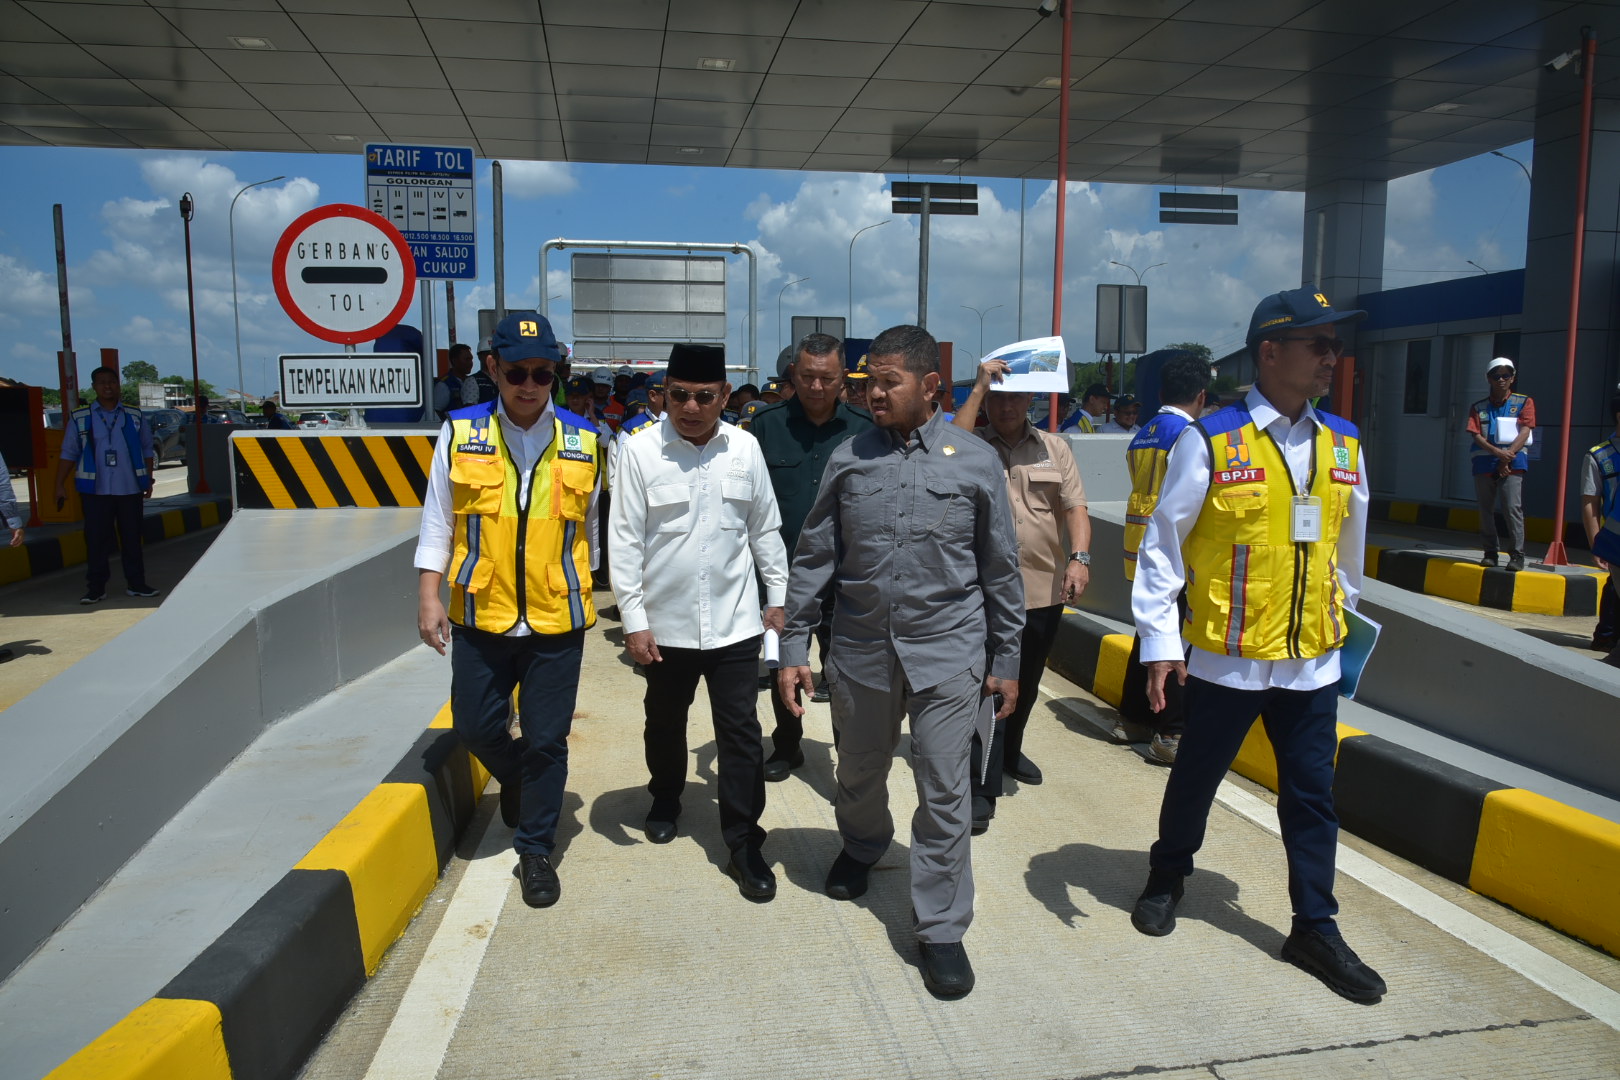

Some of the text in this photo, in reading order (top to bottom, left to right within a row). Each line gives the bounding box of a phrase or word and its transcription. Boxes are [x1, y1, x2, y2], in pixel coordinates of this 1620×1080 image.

[374, 148, 465, 170] TARIF TOL
[386, 177, 453, 187] GOLONGAN
[394, 190, 401, 198] II
[413, 191, 423, 199] III
[433, 191, 445, 199] IV
[456, 192, 465, 200] V
[297, 241, 390, 261] GERBANG
[410, 245, 469, 259] AN SALDO
[423, 261, 467, 274] CUKUP
[330, 294, 365, 312] TOL
[289, 367, 412, 395] TEMPELKAN KARTU
[459, 444, 483, 452] SAMPU
[561, 451, 590, 461] YONGKY
[1221, 470, 1257, 482] BPJT
